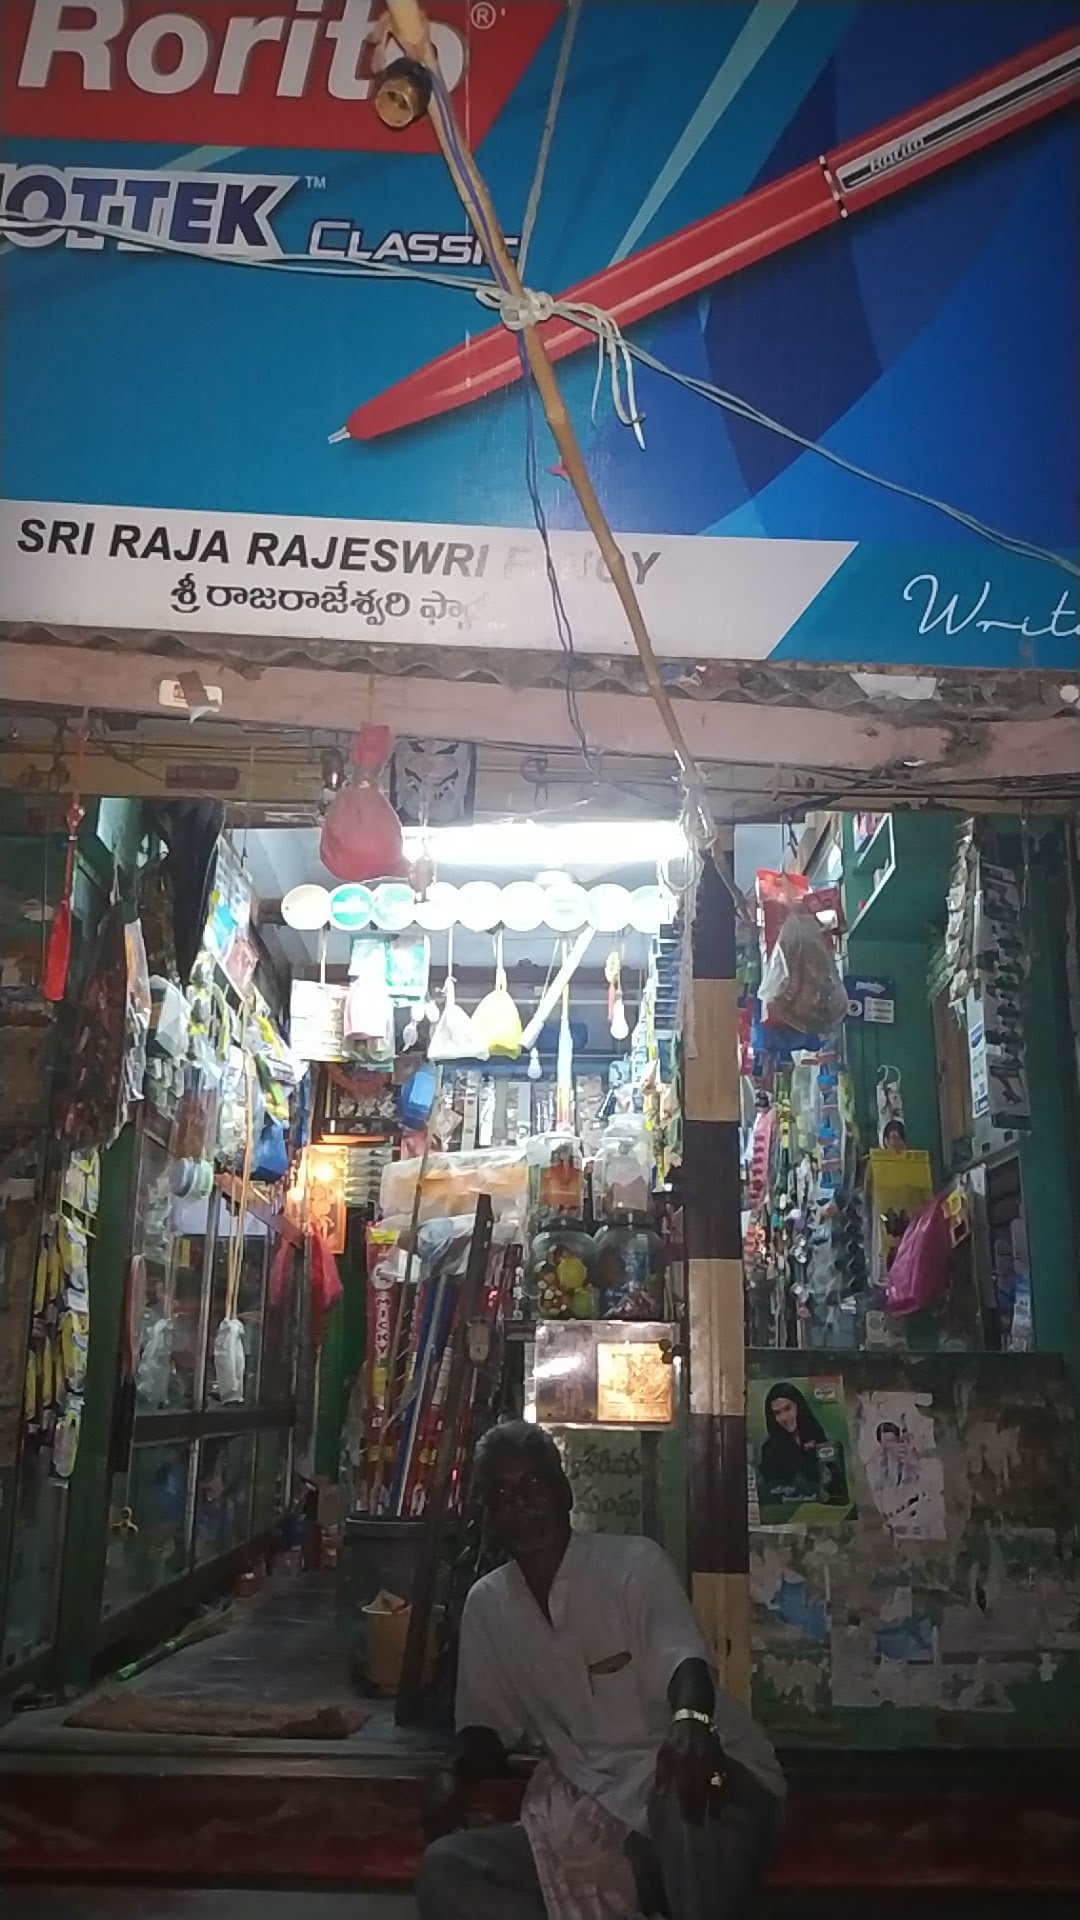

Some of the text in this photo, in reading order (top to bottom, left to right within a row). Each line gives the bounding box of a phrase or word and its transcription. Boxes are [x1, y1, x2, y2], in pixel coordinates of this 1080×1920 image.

[0, 166, 290, 252] OTTEK
[17, 518, 95, 556] SRI
[108, 523, 230, 565] RAJA
[246, 531, 489, 579] RAJESWRI
[171, 572, 201, 614] శ్రీ
[206, 580, 411, 626] రాజరాజేశ్వరి
